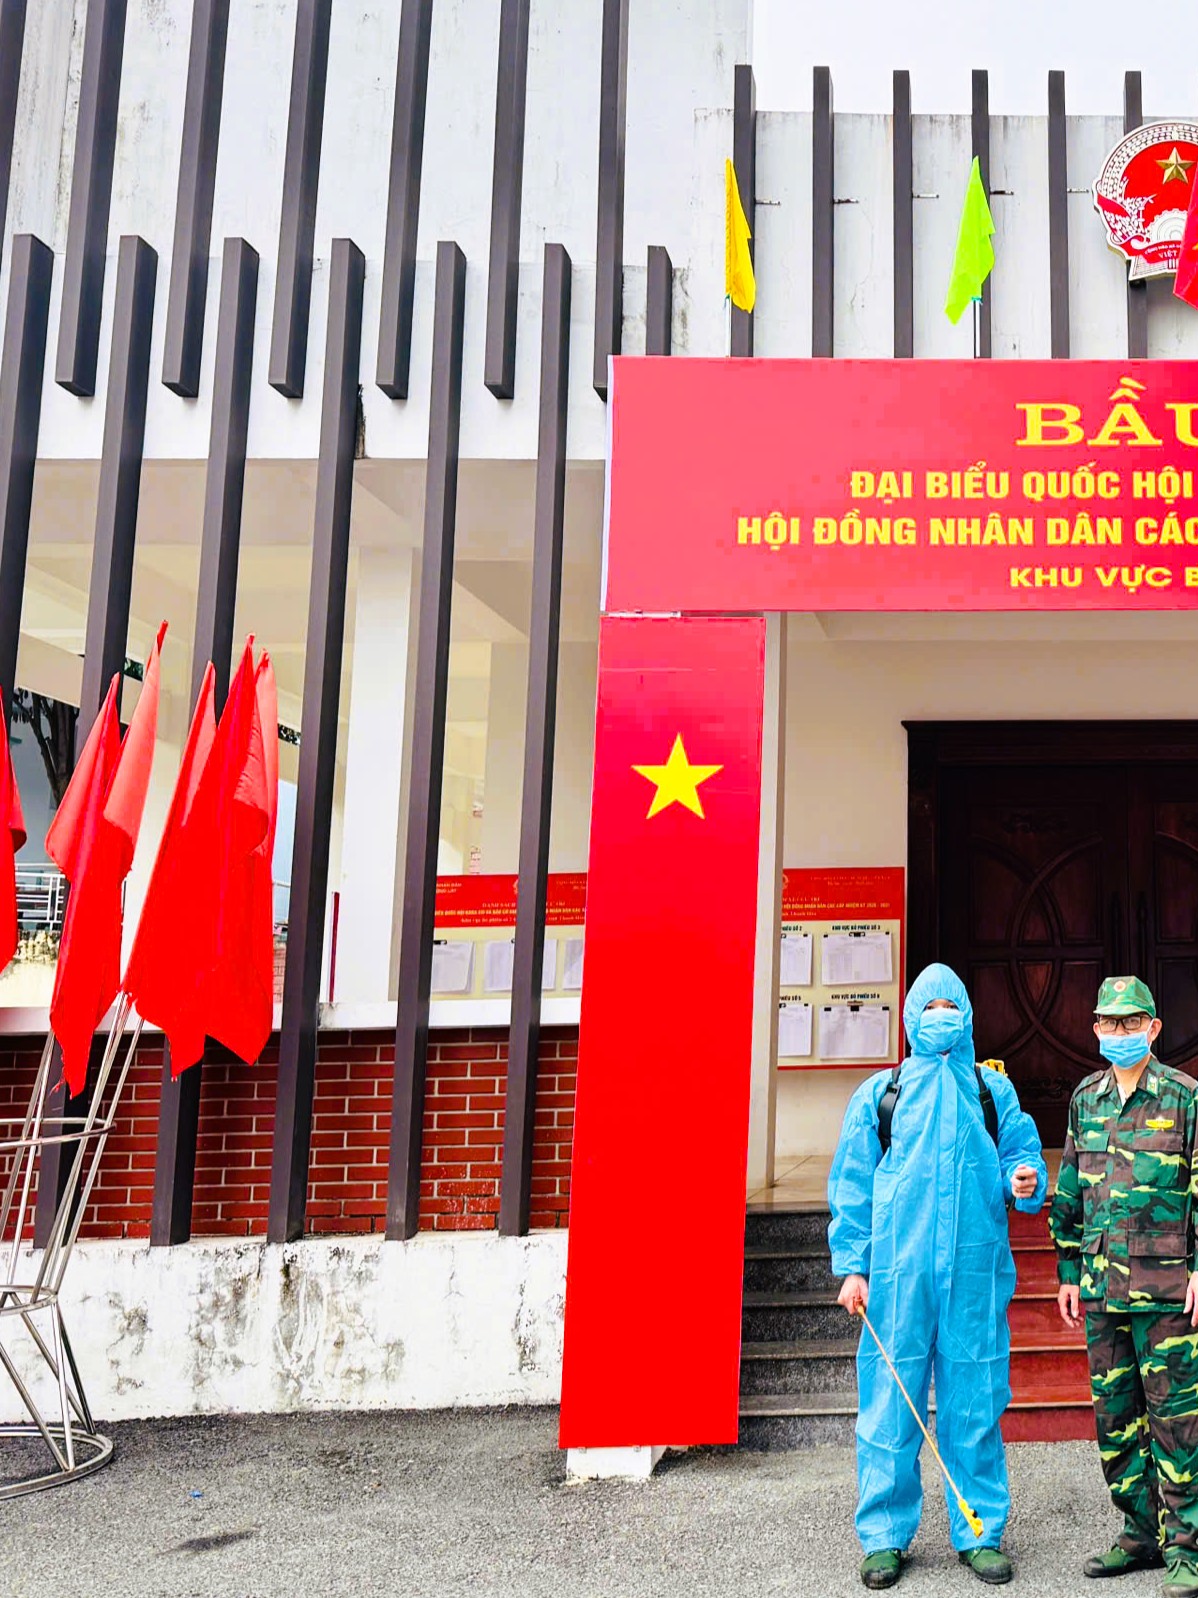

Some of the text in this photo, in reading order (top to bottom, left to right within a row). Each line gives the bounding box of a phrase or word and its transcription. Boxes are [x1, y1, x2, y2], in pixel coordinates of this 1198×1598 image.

[850, 471, 912, 504] ĐẠI
[926, 461, 1009, 499] BIỂU
[1023, 463, 1120, 502] QUỐC
[1133, 466, 1192, 504] HỘI
[738, 511, 800, 551] HỘI
[812, 508, 916, 545] ĐỒNG
[930, 512, 1033, 545] NHÂN
[1047, 512, 1121, 545] DÂN
[1010, 568, 1082, 587] KHU
[1095, 565, 1172, 593] VỰC
